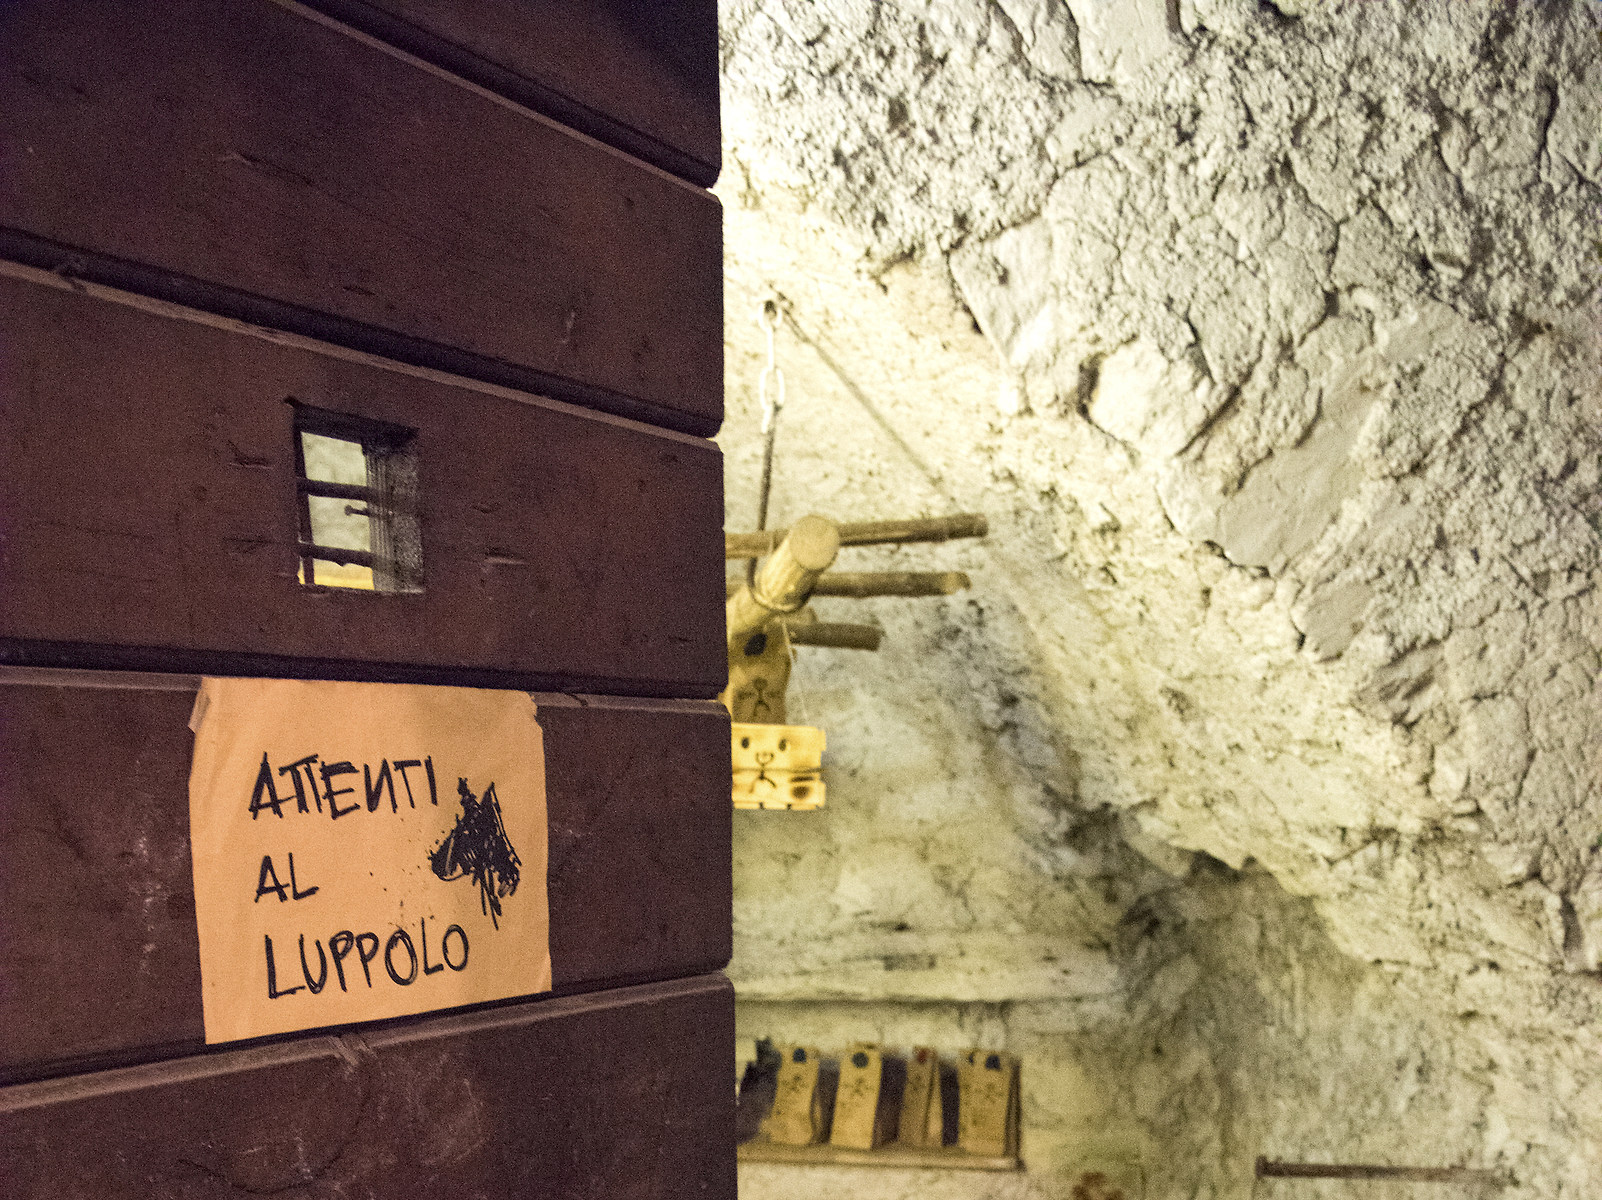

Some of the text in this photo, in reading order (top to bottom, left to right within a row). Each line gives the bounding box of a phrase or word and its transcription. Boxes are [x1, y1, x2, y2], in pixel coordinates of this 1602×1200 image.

[249, 752, 438, 820] ATTENTI
[254, 852, 320, 903] AL
[265, 917, 470, 1000] LUPPOLO
